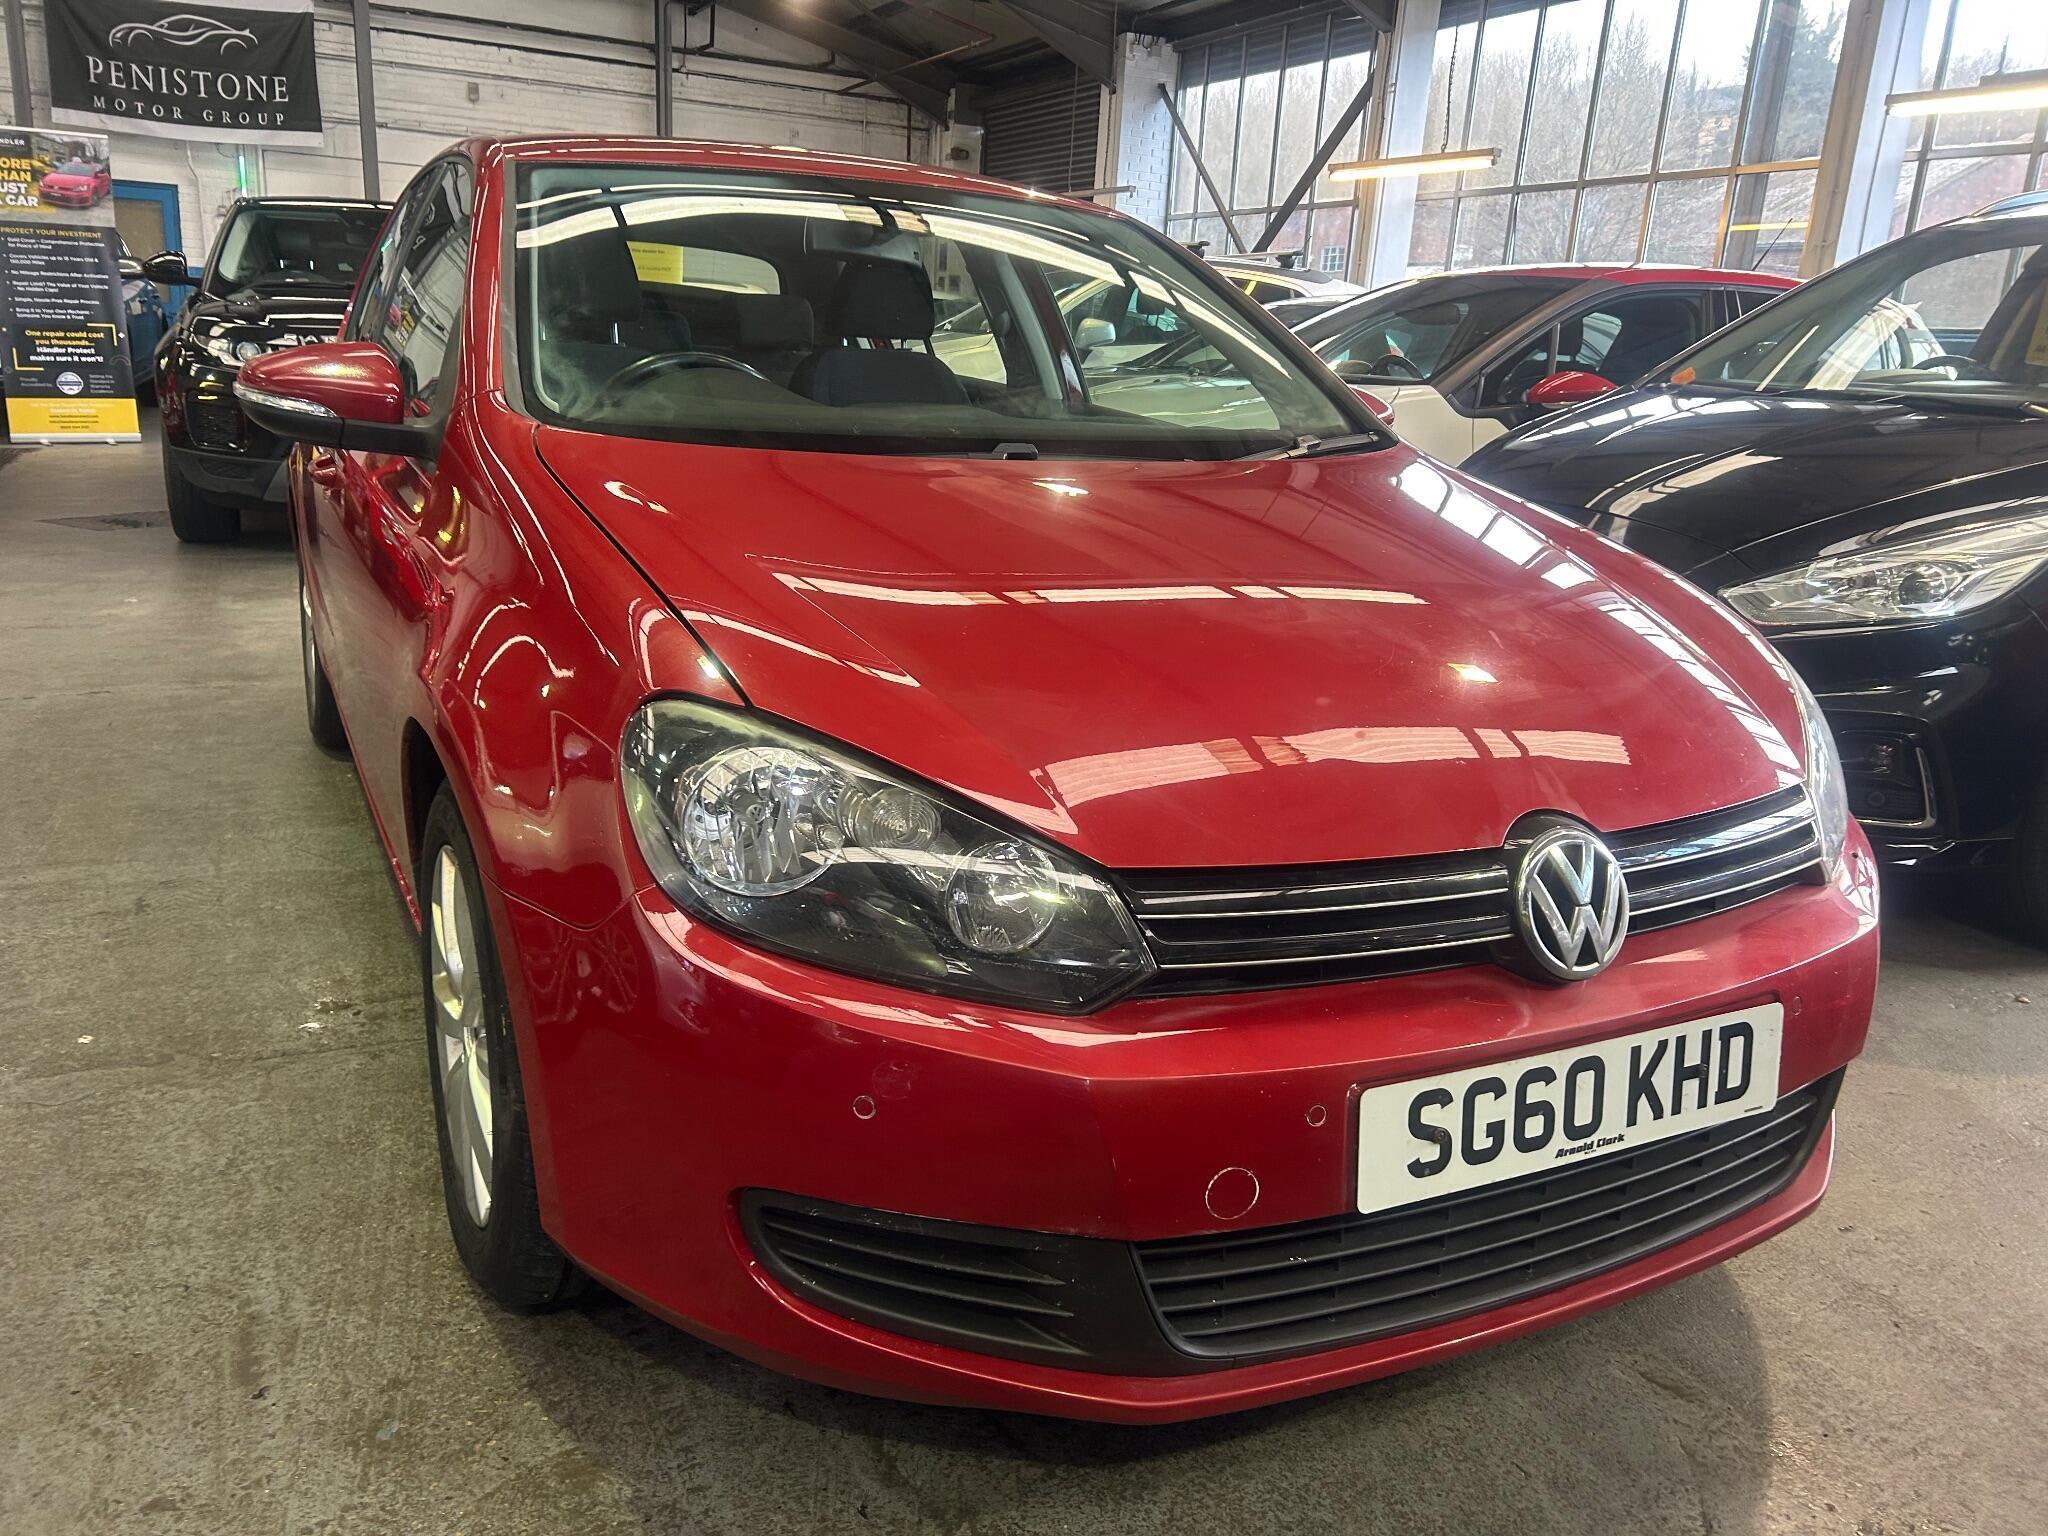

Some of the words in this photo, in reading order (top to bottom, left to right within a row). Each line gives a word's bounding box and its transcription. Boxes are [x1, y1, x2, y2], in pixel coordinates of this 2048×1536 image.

[85, 55, 289, 102] PENISTONE
[93, 95, 183, 119] MOTOR
[203, 109, 284, 125] GROUP
[0, 157, 31, 170] ORE
[0, 182, 28, 194] UST
[5, 194, 39, 207] CAR
[0, 226, 34, 234] PROTECT
[57, 231, 102, 239] INVESTMENT
[25, 329, 41, 337] One
[42, 330, 65, 339] repair
[1407, 1055, 1606, 1179] SG60
[1626, 1021, 1754, 1128] KHD
[1555, 1140, 1595, 1159] Arnold
[1596, 1133, 1626, 1148] Clark
